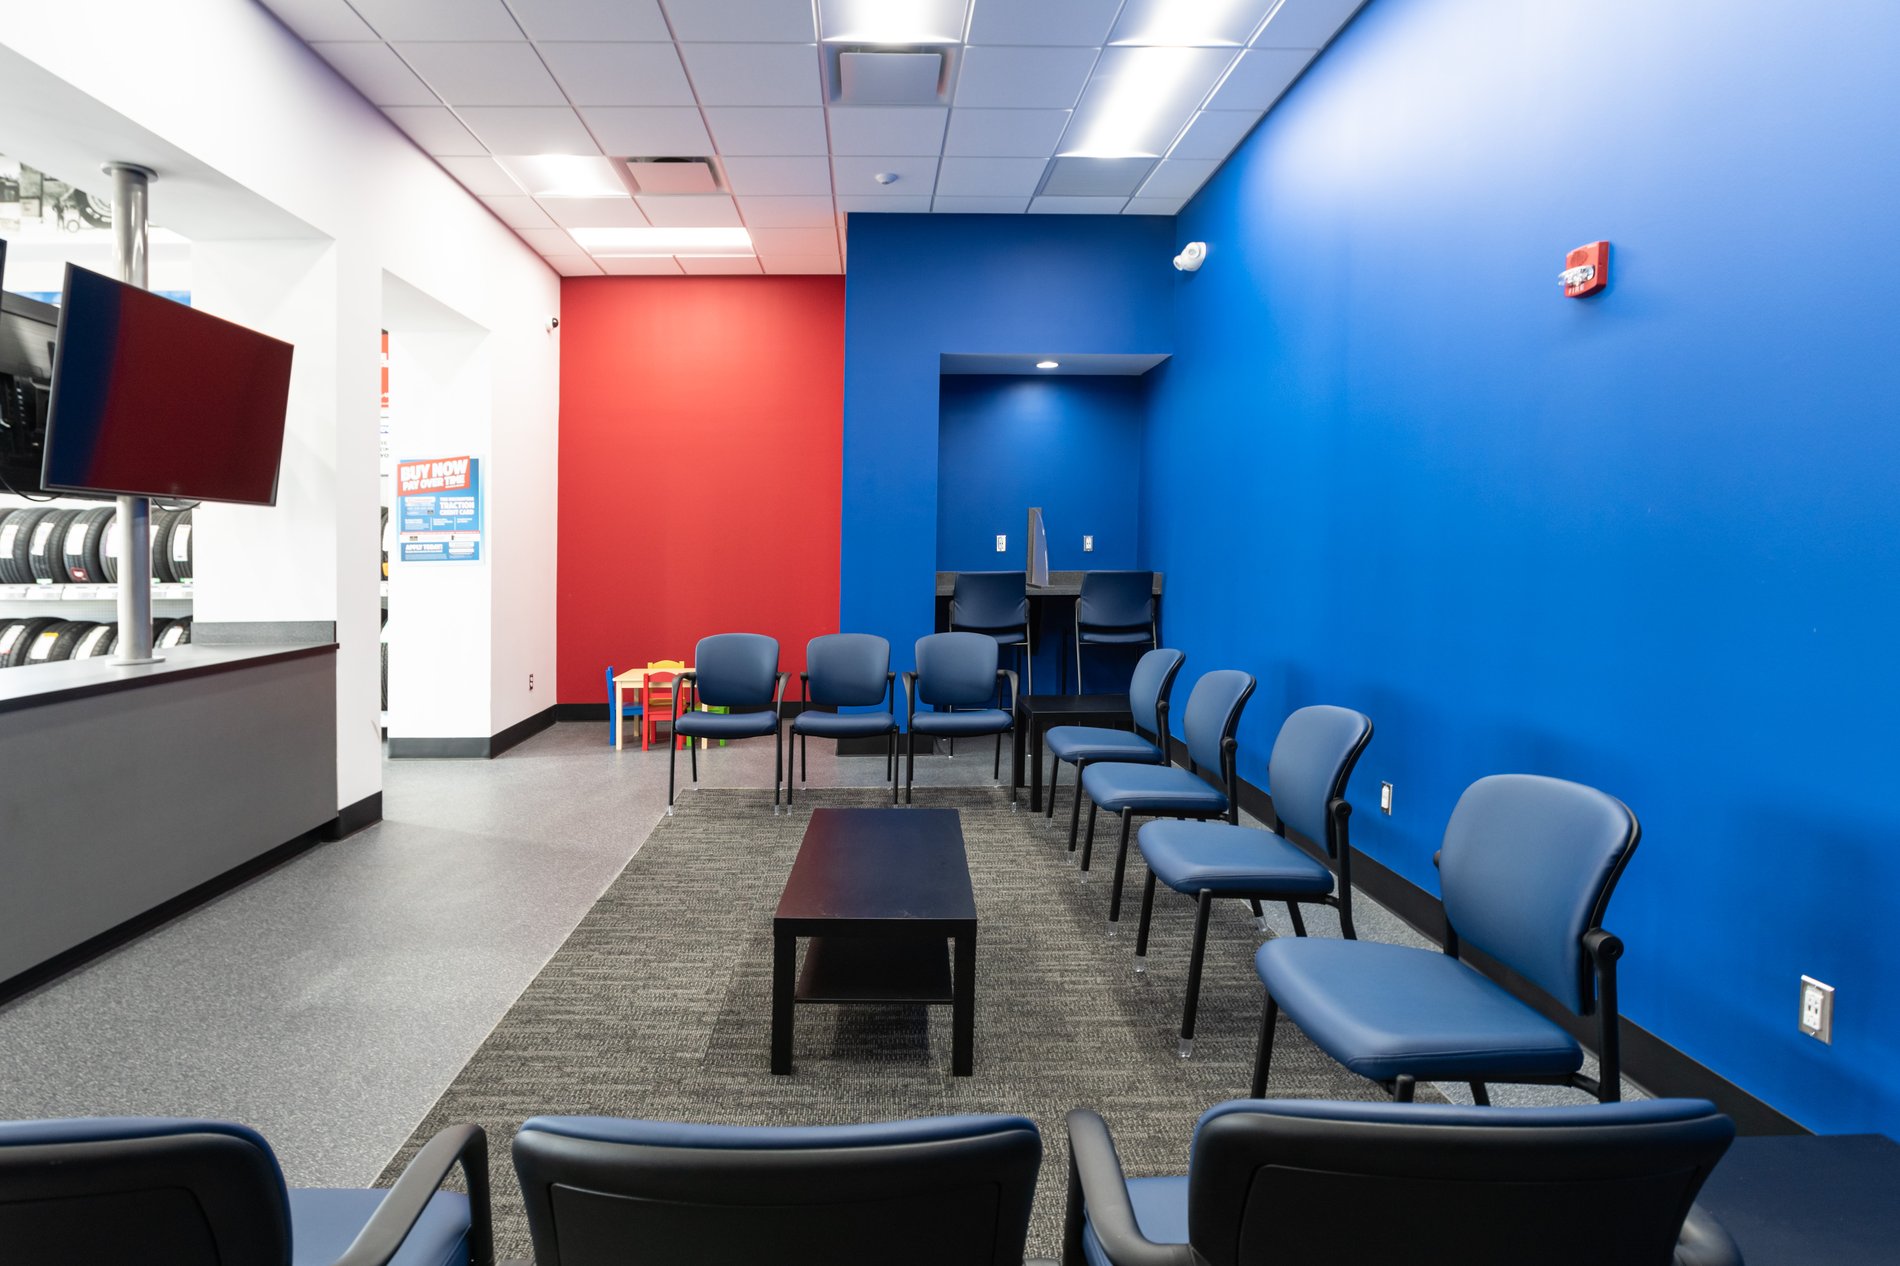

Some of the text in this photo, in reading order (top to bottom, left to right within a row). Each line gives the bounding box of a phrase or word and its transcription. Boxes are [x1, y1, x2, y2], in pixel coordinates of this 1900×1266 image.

[1567, 283, 1585, 295] FIRE
[400, 459, 468, 482] BUY NOW
[402, 474, 465, 491] PAY OVER TIME
